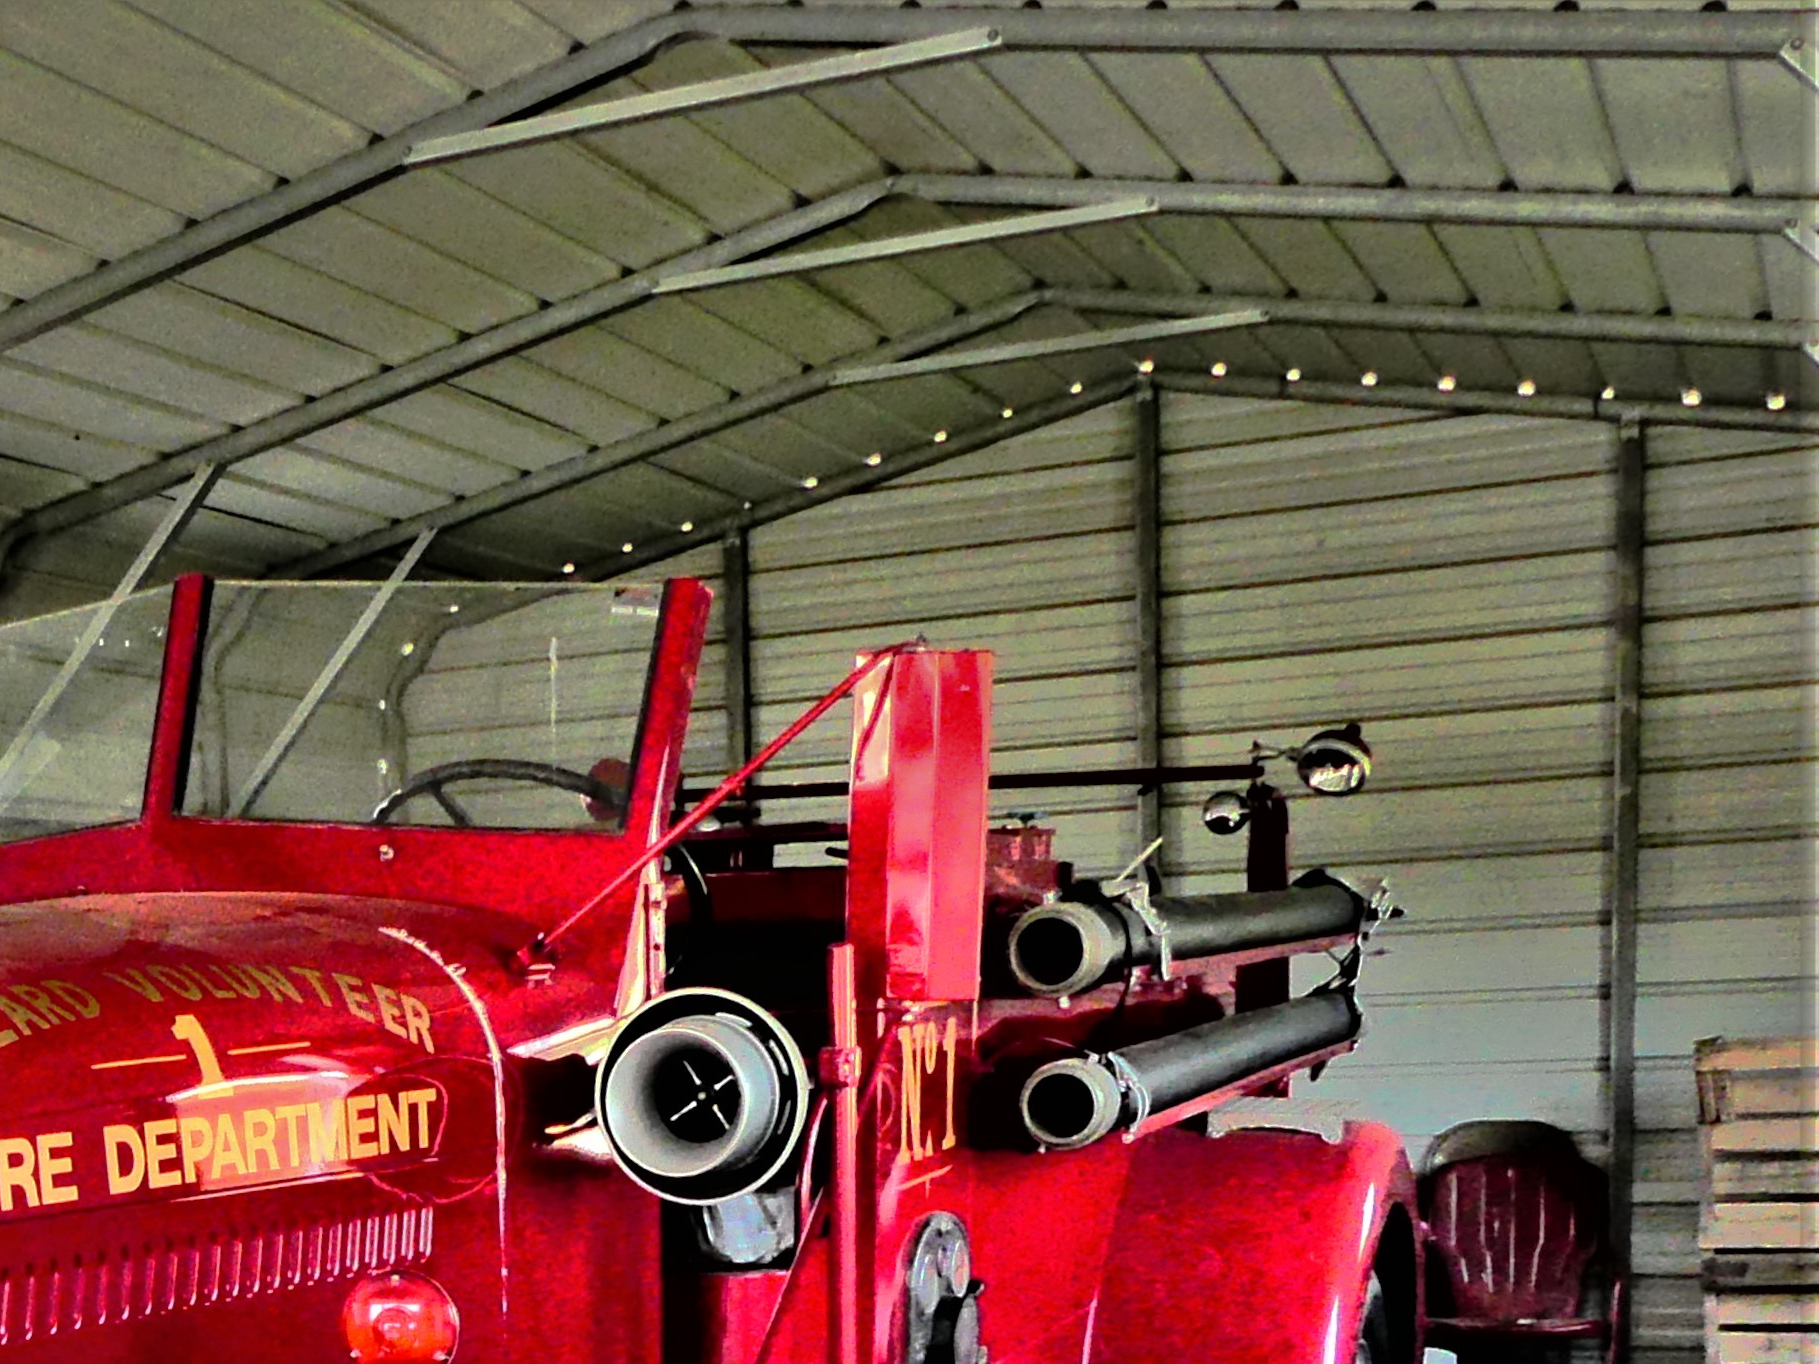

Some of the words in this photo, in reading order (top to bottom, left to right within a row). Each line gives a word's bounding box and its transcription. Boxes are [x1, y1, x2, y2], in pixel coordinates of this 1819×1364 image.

[102, 963, 435, 1054] VOLUNTEER
[171, 1014, 234, 1099] 1
[104, 1088, 437, 1195] DEPARTMENT
